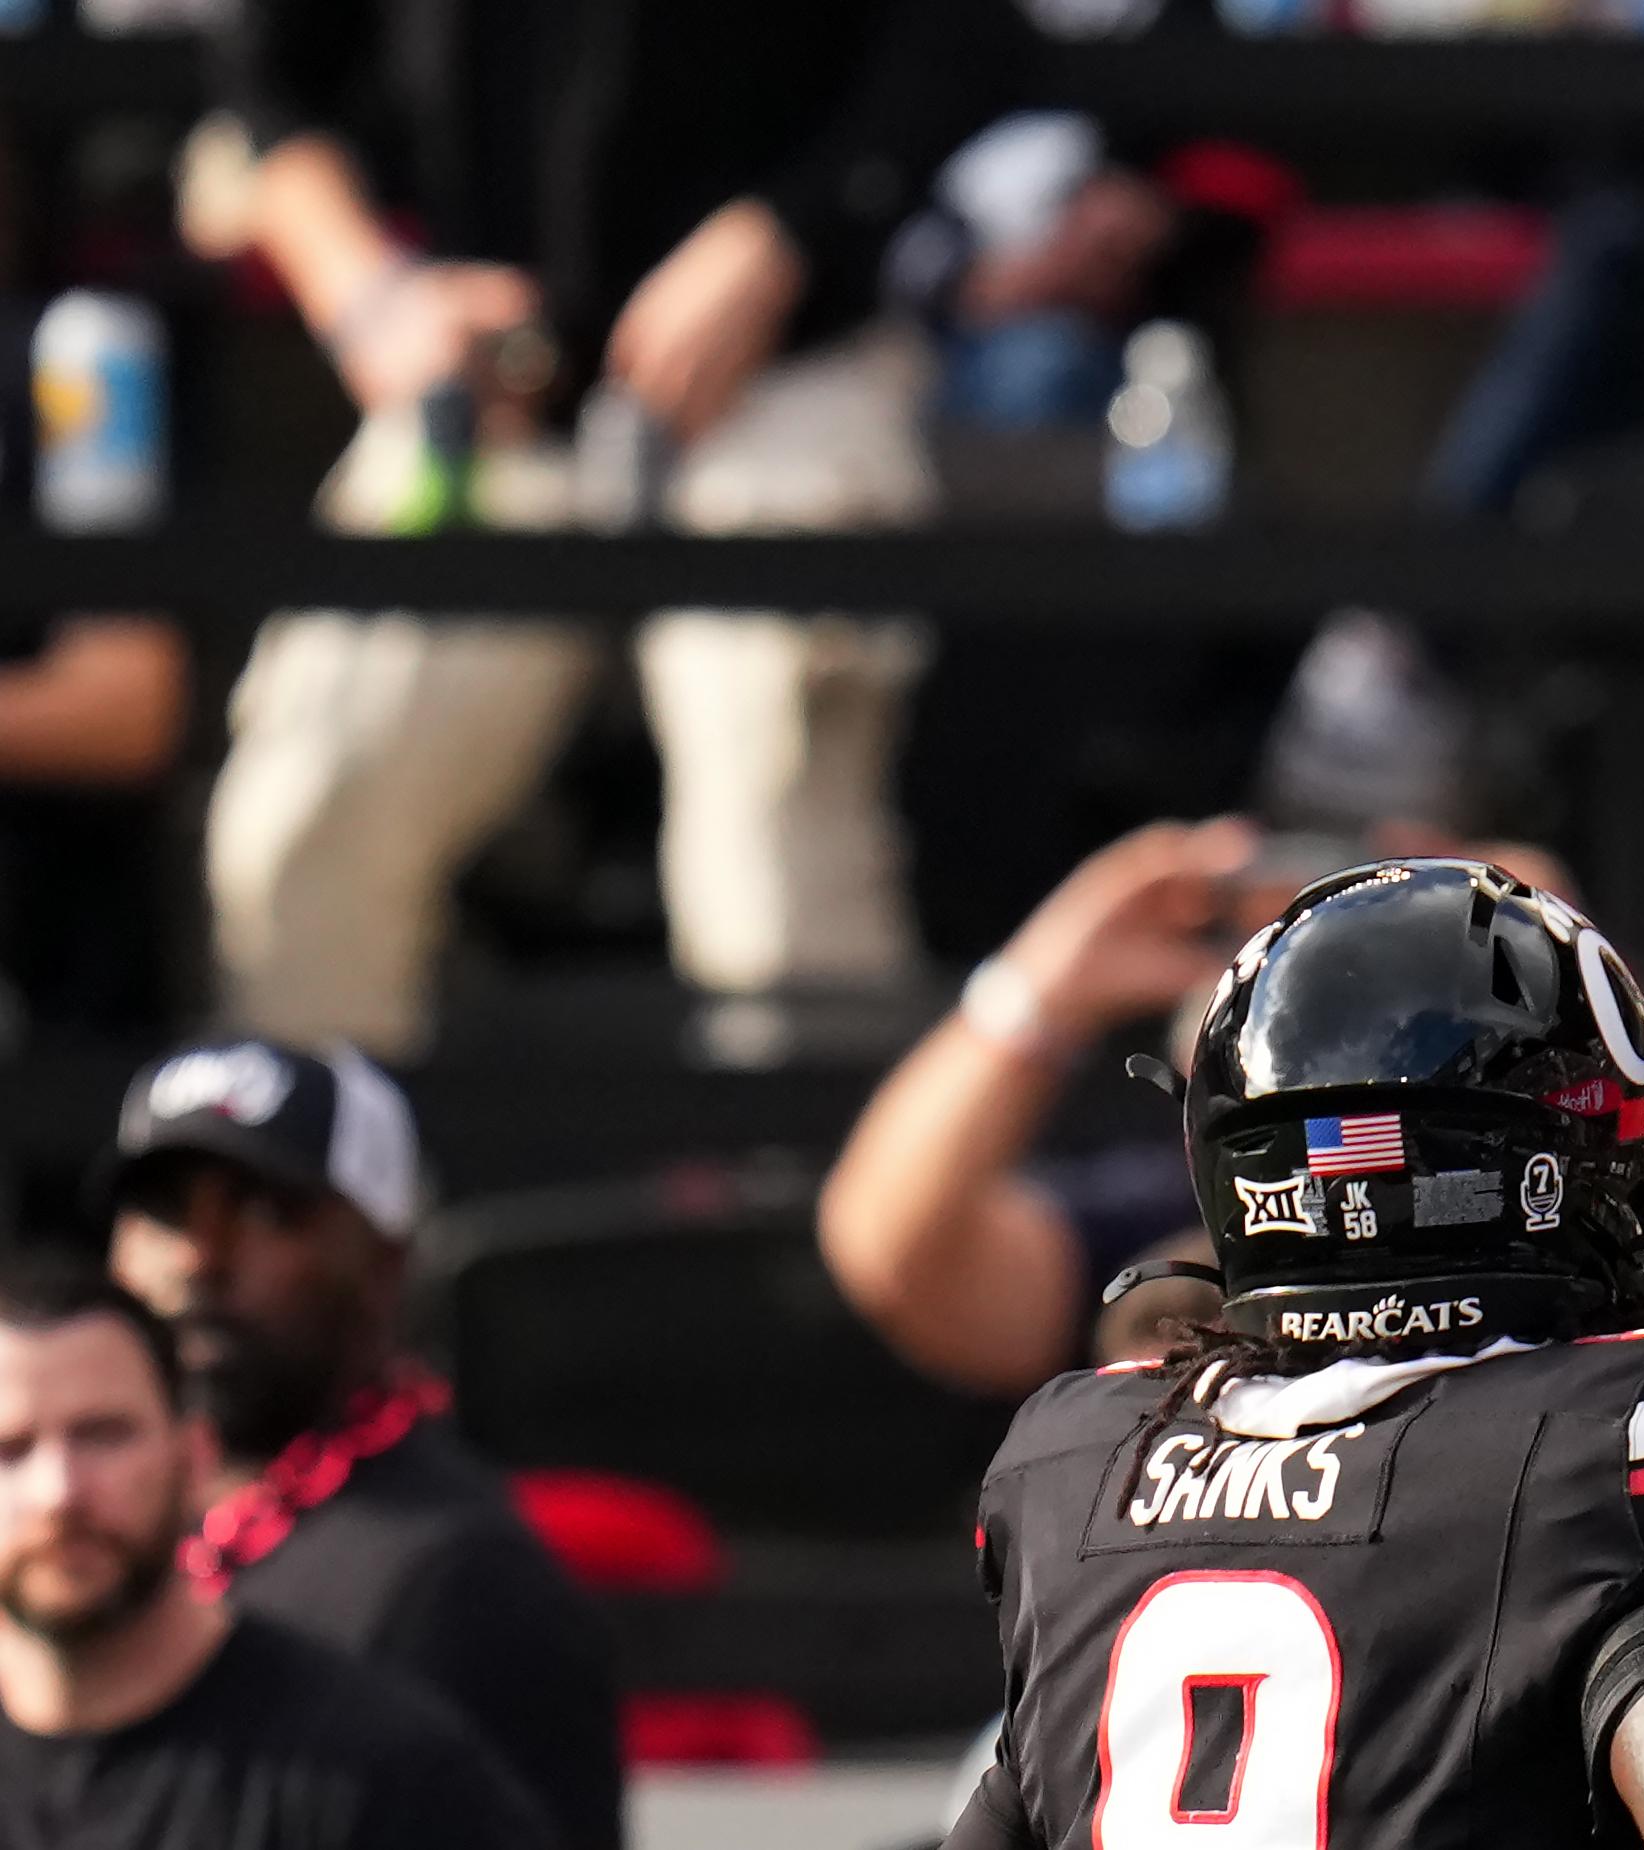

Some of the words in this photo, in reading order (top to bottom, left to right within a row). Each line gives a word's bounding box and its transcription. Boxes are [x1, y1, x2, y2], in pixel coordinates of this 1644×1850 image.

[1533, 1164, 1549, 1194] 7
[1340, 1181, 1373, 1212] JK
[1343, 1210, 1378, 1240] 58
[1281, 1294, 1484, 1342] BEARCATS
[1129, 1422, 1366, 1527] SANKS
